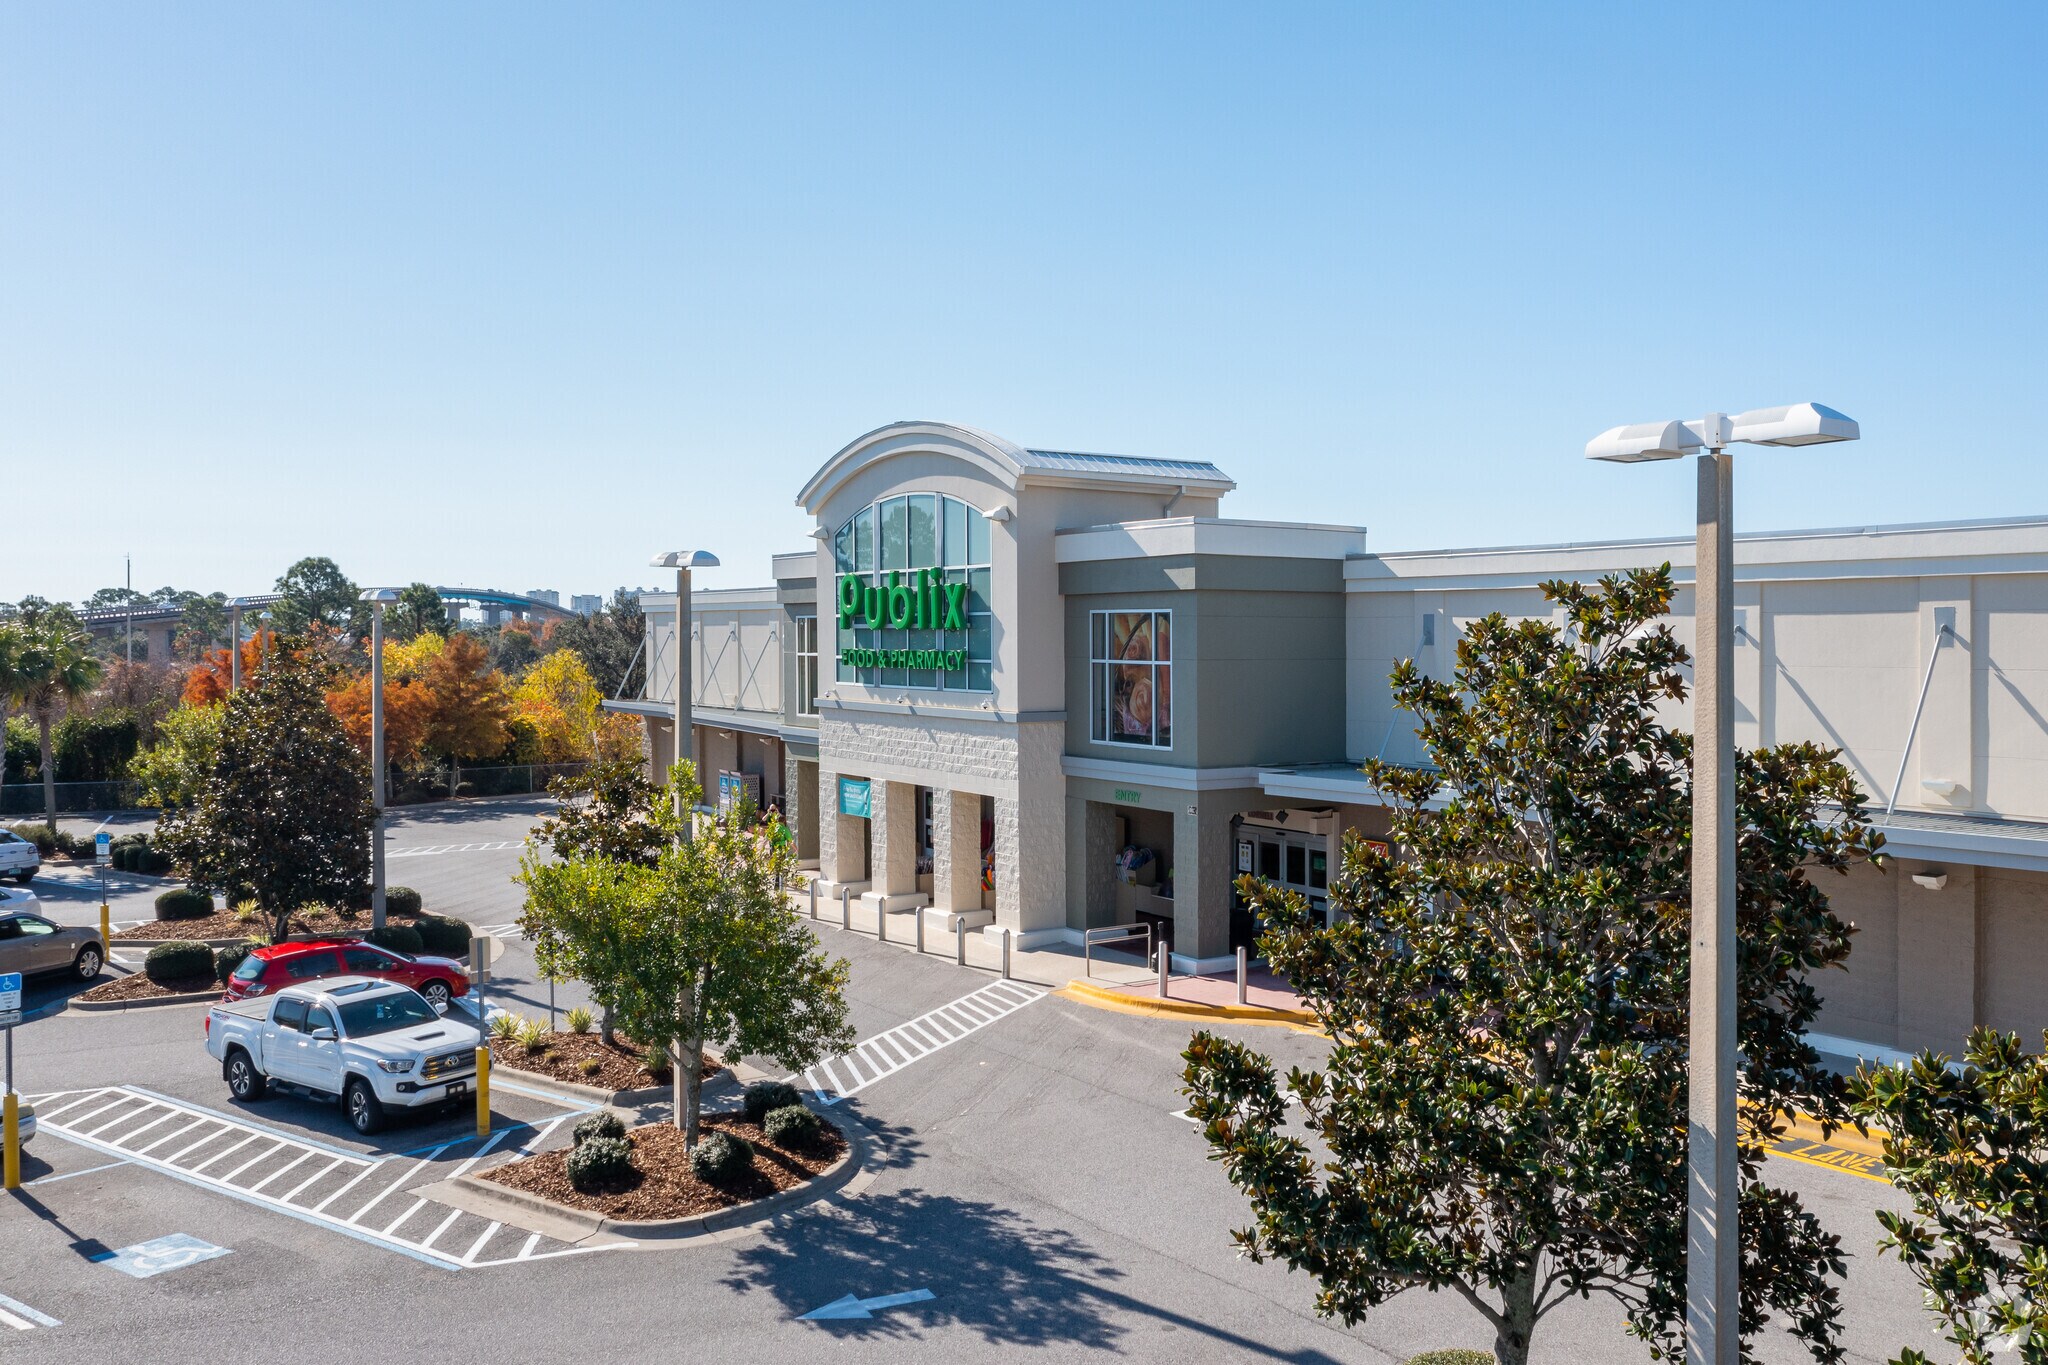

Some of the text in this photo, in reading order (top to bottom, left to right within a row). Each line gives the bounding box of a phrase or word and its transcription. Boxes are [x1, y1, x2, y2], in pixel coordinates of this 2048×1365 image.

[840, 567, 967, 630] Publix
[842, 649, 966, 671] FOOD & PHARMACY
[1115, 789, 1141, 803] ENTRY
[1791, 1144, 1884, 1172] LANE
